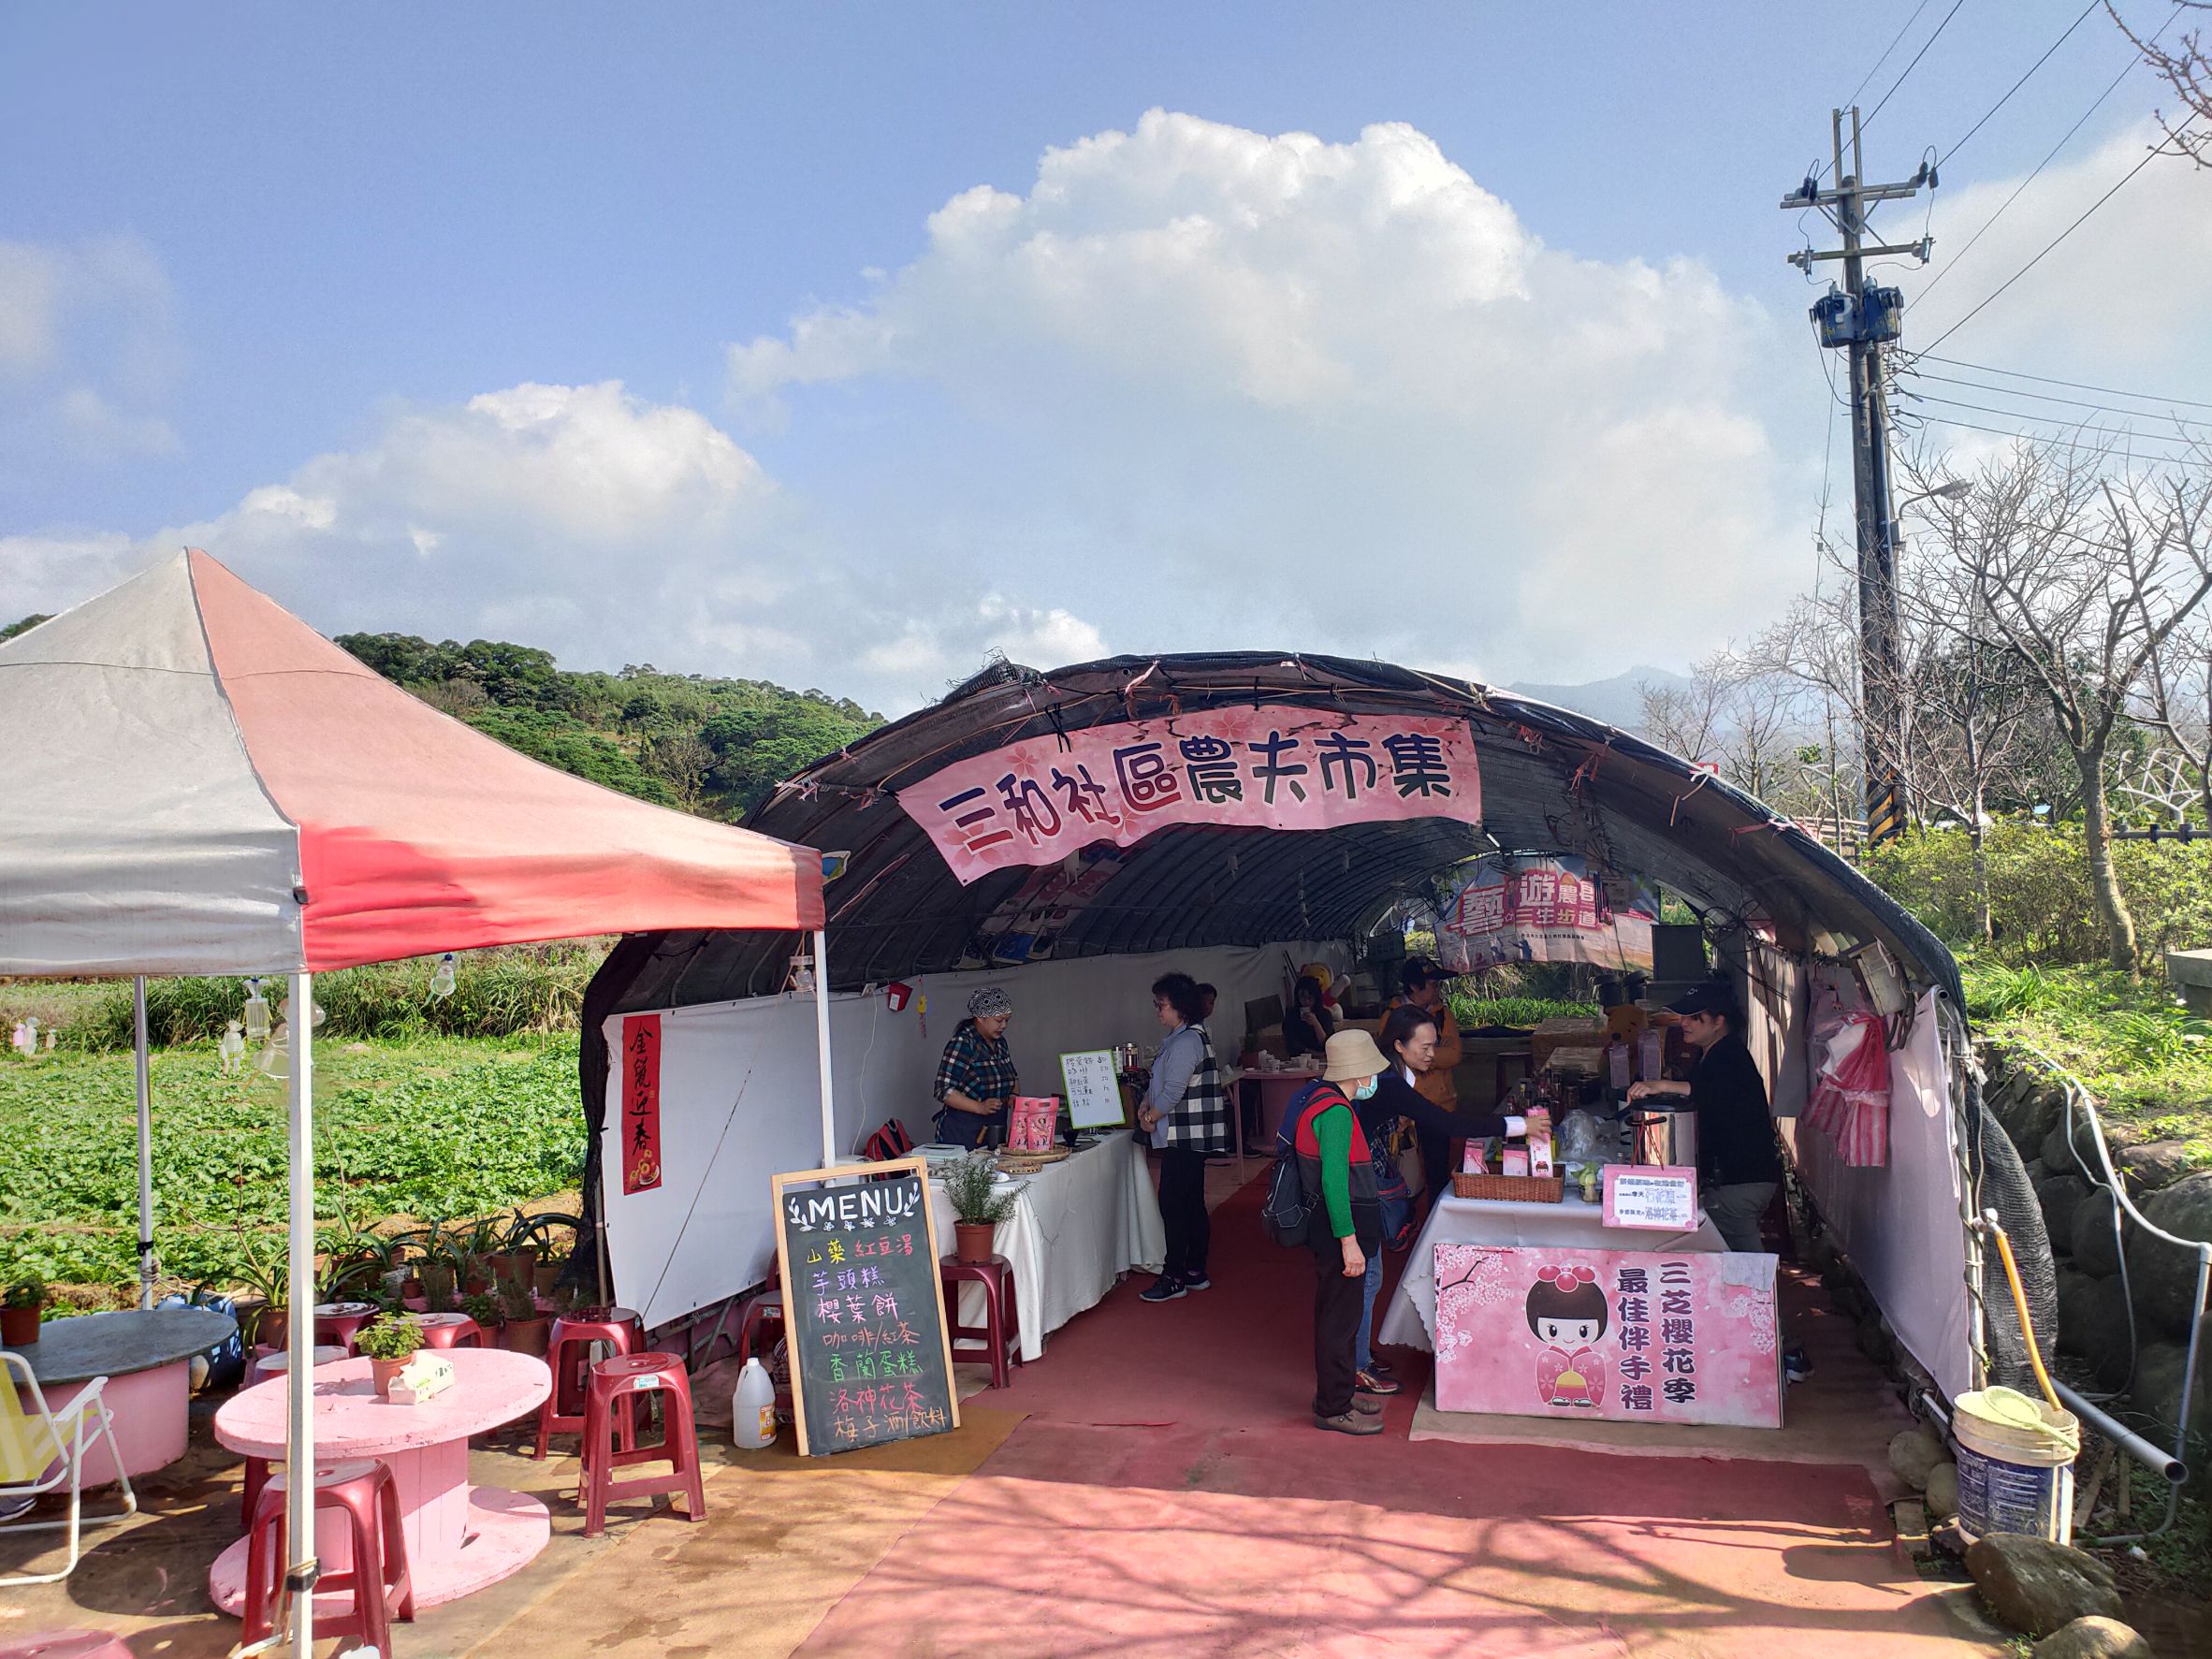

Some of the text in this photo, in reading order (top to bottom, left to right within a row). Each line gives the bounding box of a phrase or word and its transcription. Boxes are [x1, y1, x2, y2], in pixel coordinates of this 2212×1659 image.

[939, 733, 1451, 852] 三和社區農夫市集
[1516, 908, 1596, 927] 三生步道
[808, 1186, 904, 1223] MENU
[812, 1265, 884, 1296] 芋頭糕
[818, 1292, 898, 1324] 櫻葉餅
[1617, 1268, 1652, 1411] 最佳伴手禮
[1660, 1261, 1695, 1404] 三芝櫻花季
[830, 1348, 924, 1383] 香蘭蛋糕
[829, 1382, 925, 1414] 洛神花茶
